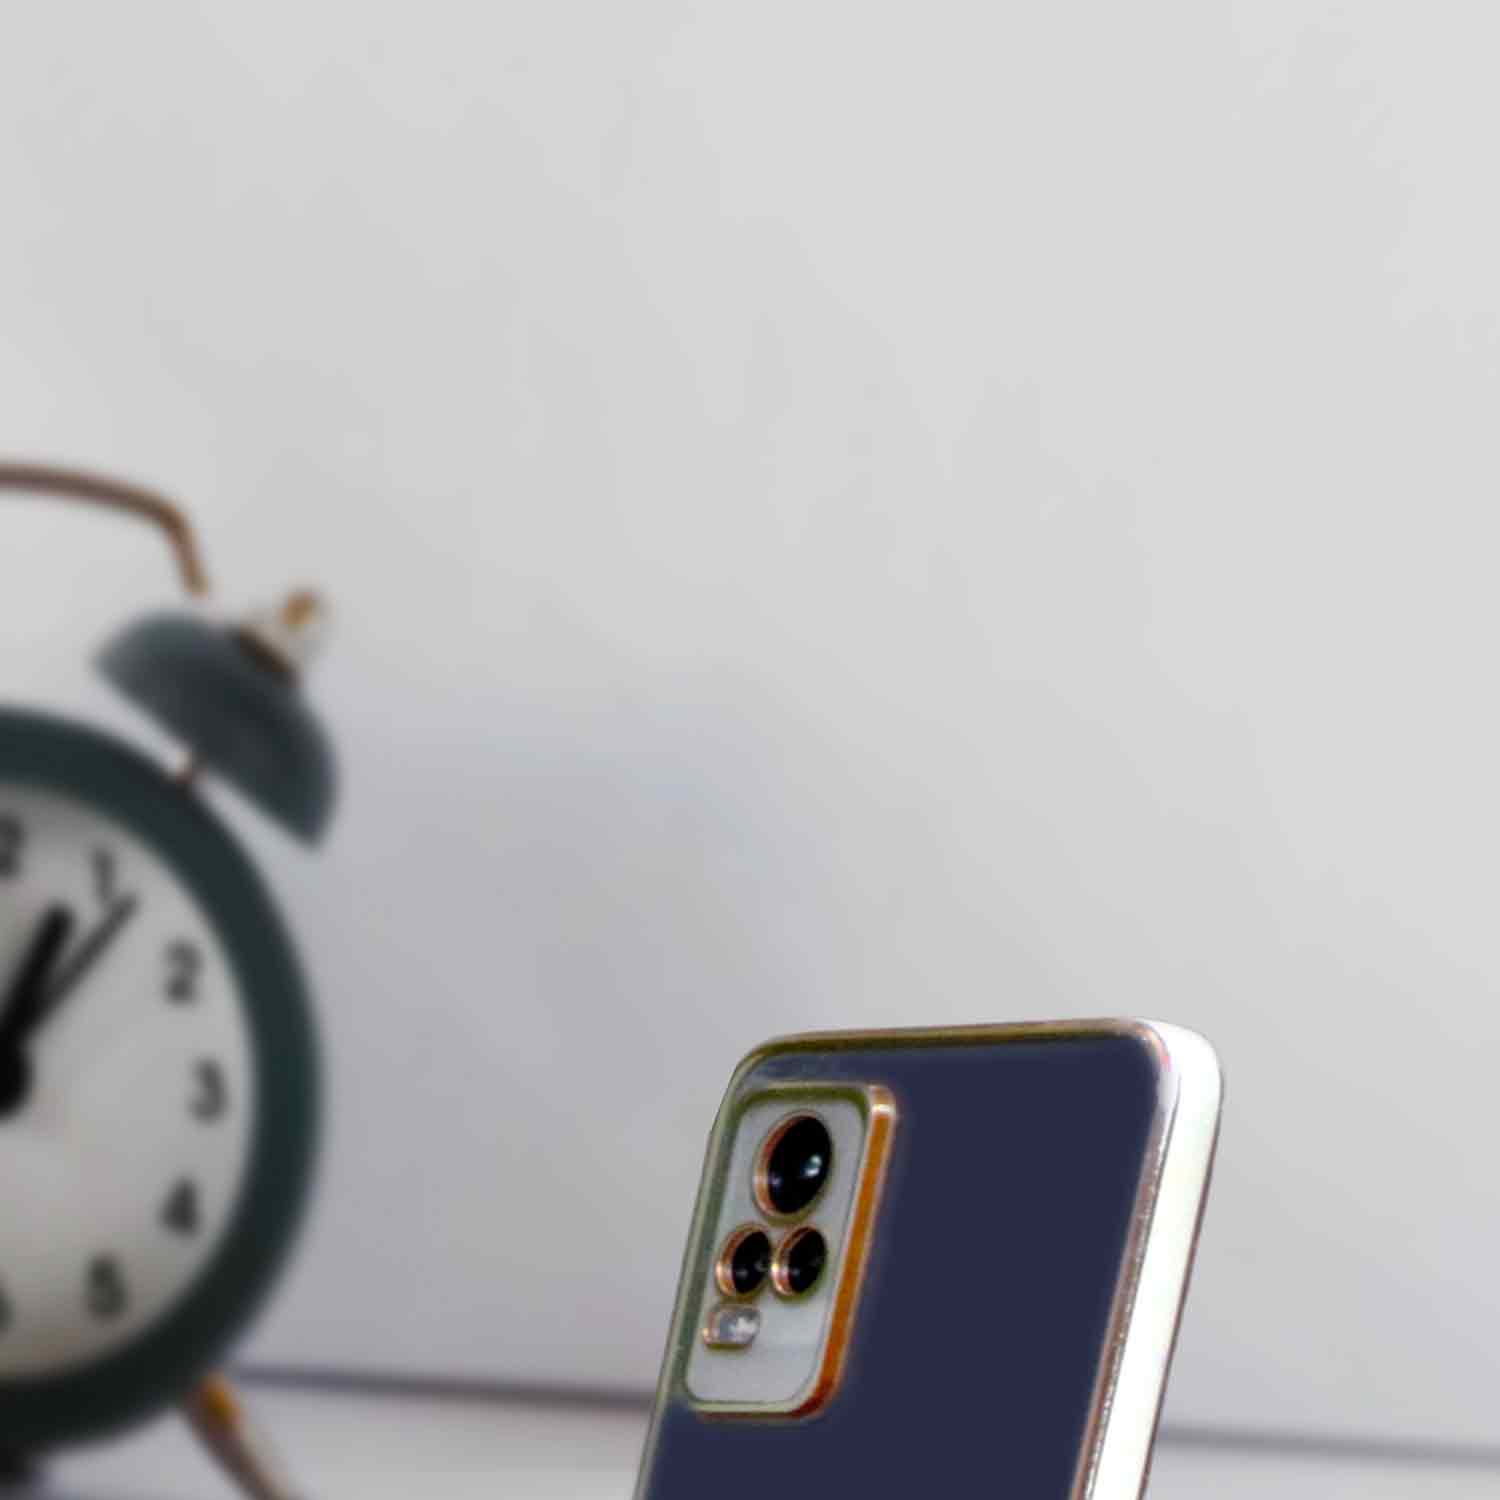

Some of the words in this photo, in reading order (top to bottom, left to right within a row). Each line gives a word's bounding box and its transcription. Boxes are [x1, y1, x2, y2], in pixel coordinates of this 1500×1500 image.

[163, 940, 203, 1005] 2
[190, 1058, 225, 1123] 3
[158, 1178, 203, 1239] 4
